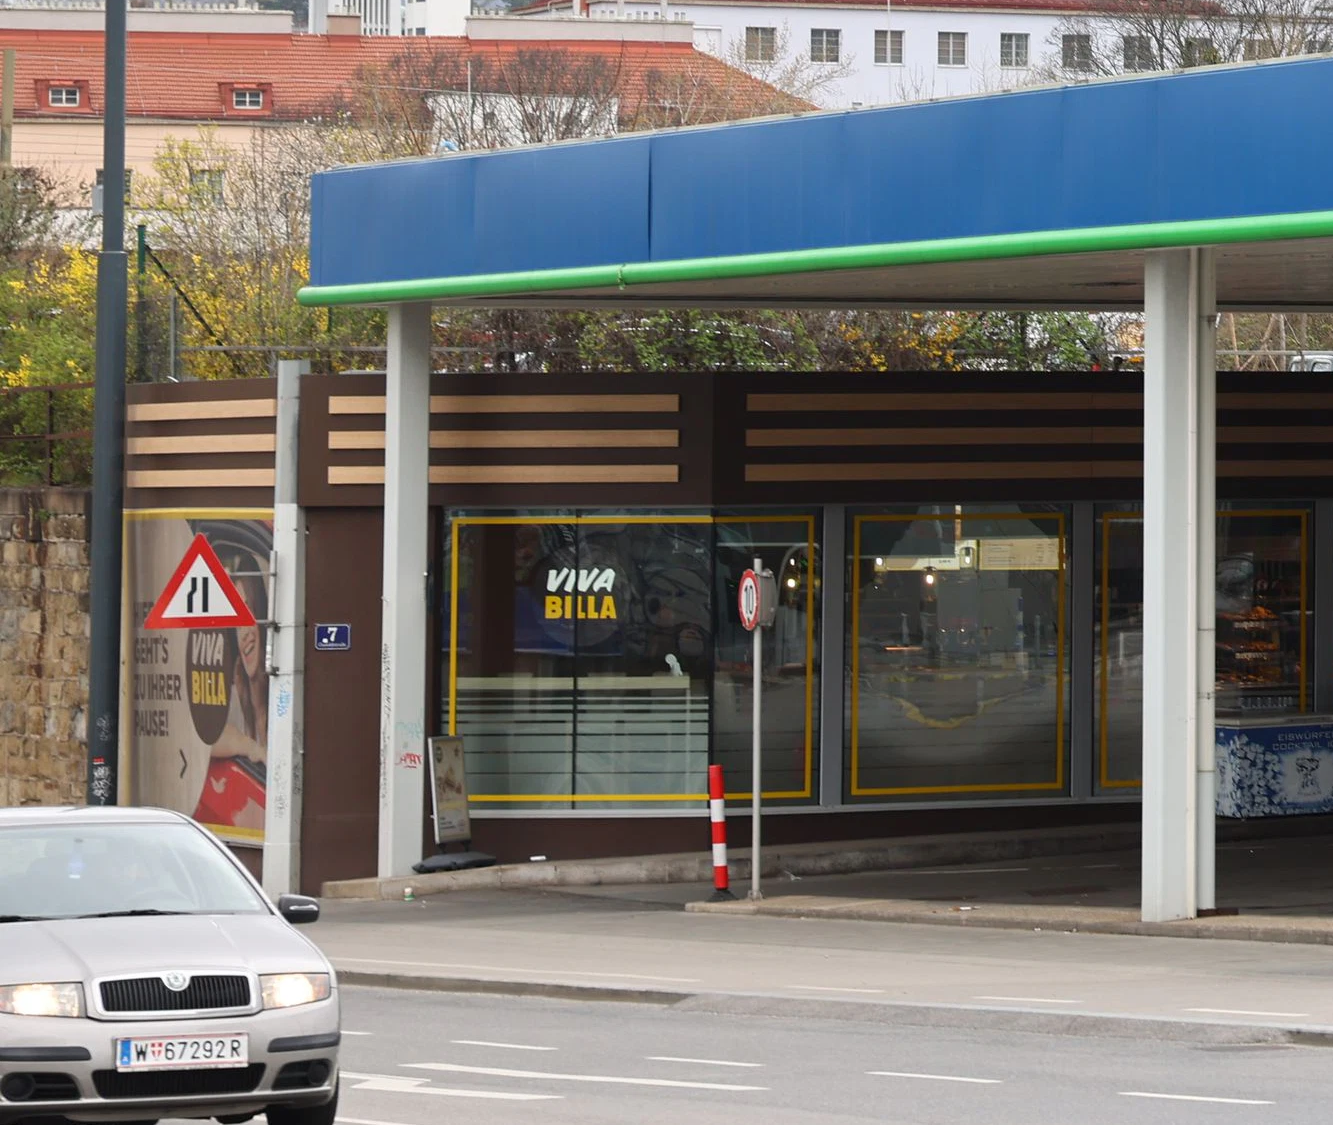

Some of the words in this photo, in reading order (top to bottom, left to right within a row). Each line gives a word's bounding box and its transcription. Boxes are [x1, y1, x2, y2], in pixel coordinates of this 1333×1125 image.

[546, 567, 616, 593] VIVA
[544, 595, 618, 619] BILLA
[191, 631, 225, 667] VIVA
[191, 670, 227, 707] BILLA
[134, 1043, 149, 1062] W
